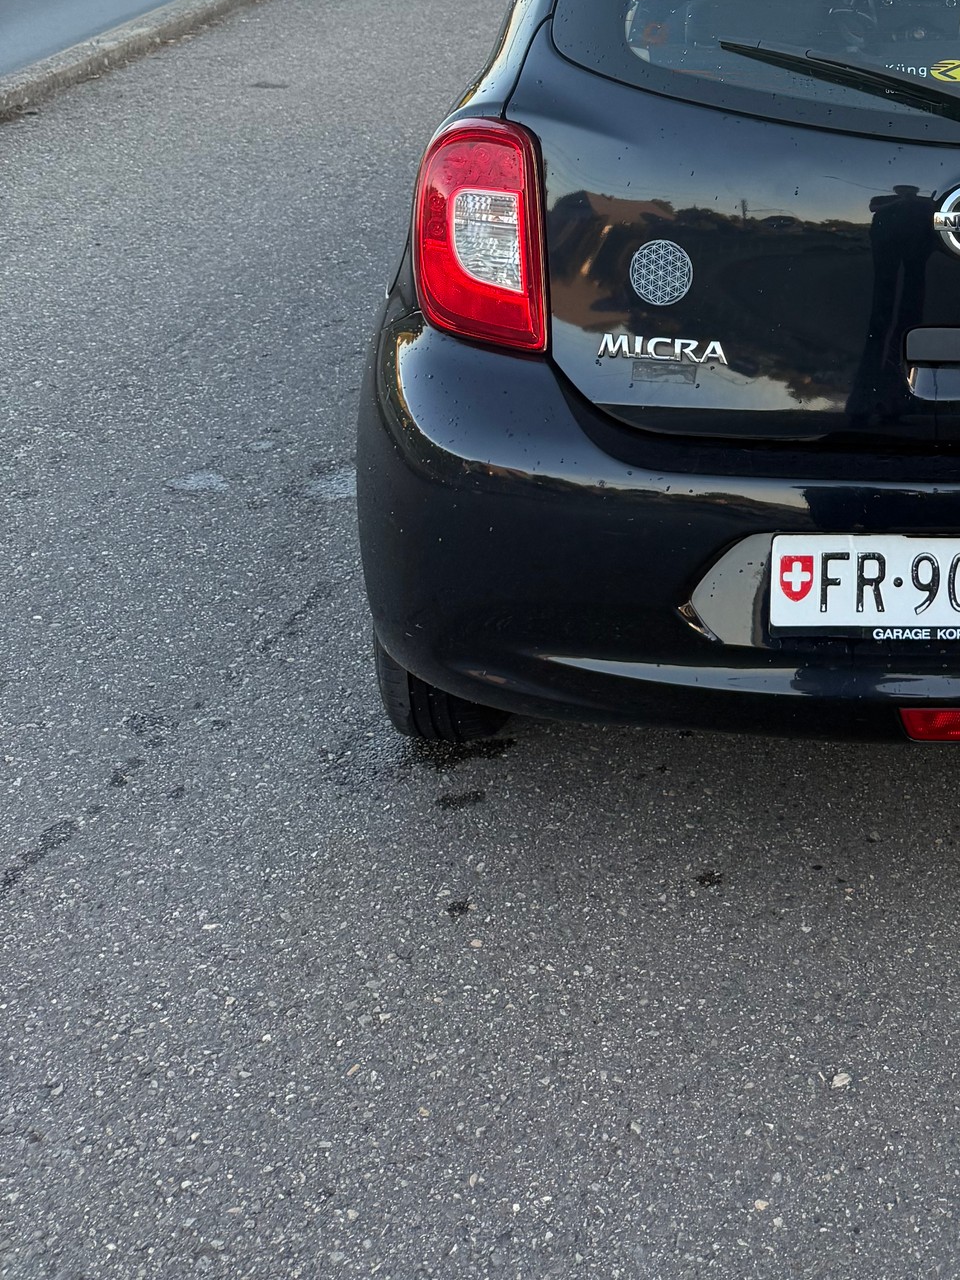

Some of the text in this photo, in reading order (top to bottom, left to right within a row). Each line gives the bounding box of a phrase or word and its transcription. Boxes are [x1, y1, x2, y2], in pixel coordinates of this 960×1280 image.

[885, 63, 928, 78] üng
[597, 333, 728, 366] MICRA
[872, 628, 931, 640] GARAGE
